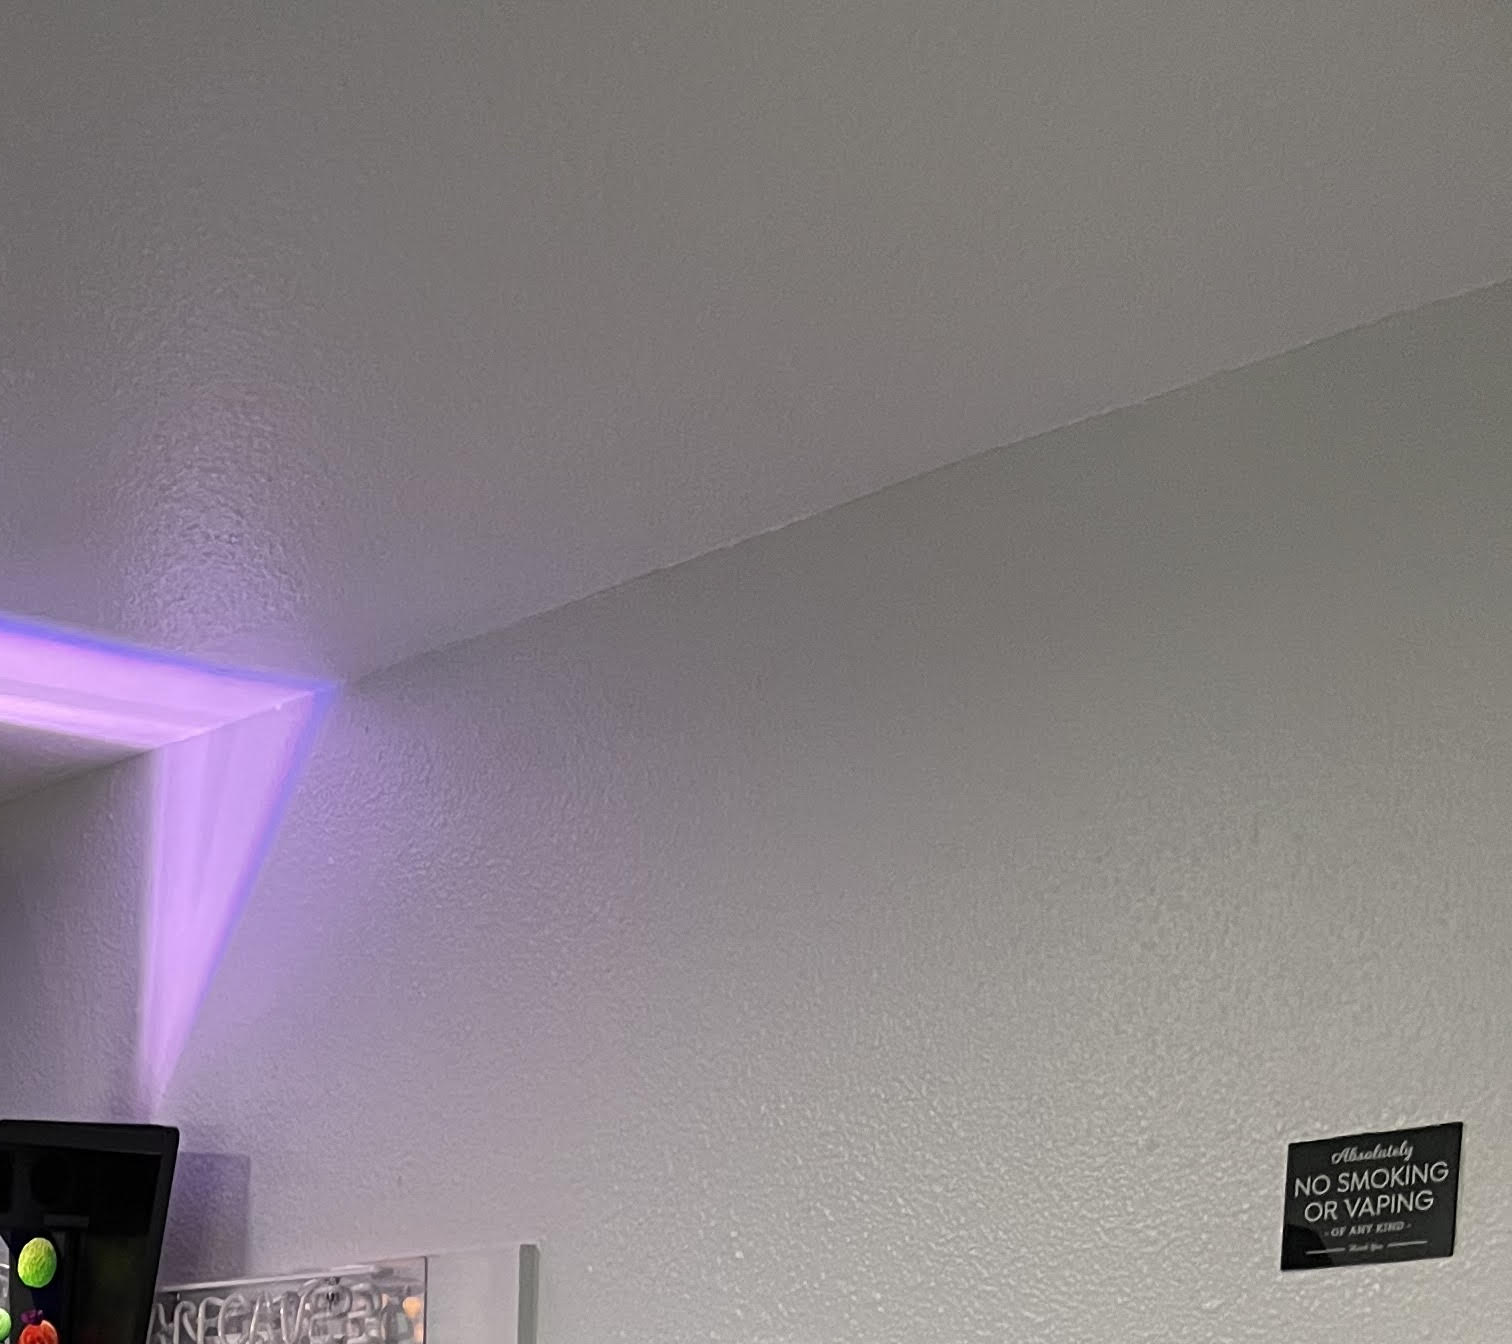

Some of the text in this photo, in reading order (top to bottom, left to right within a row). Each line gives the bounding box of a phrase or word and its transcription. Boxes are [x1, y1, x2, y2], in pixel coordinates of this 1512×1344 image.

[1331, 1140, 1414, 1164] Absolutely
[1294, 1160, 1449, 1198] NO SMOKING
[1304, 1189, 1434, 1222] OR VAPING
[1330, 1221, 1405, 1237] OF ANY KIND
